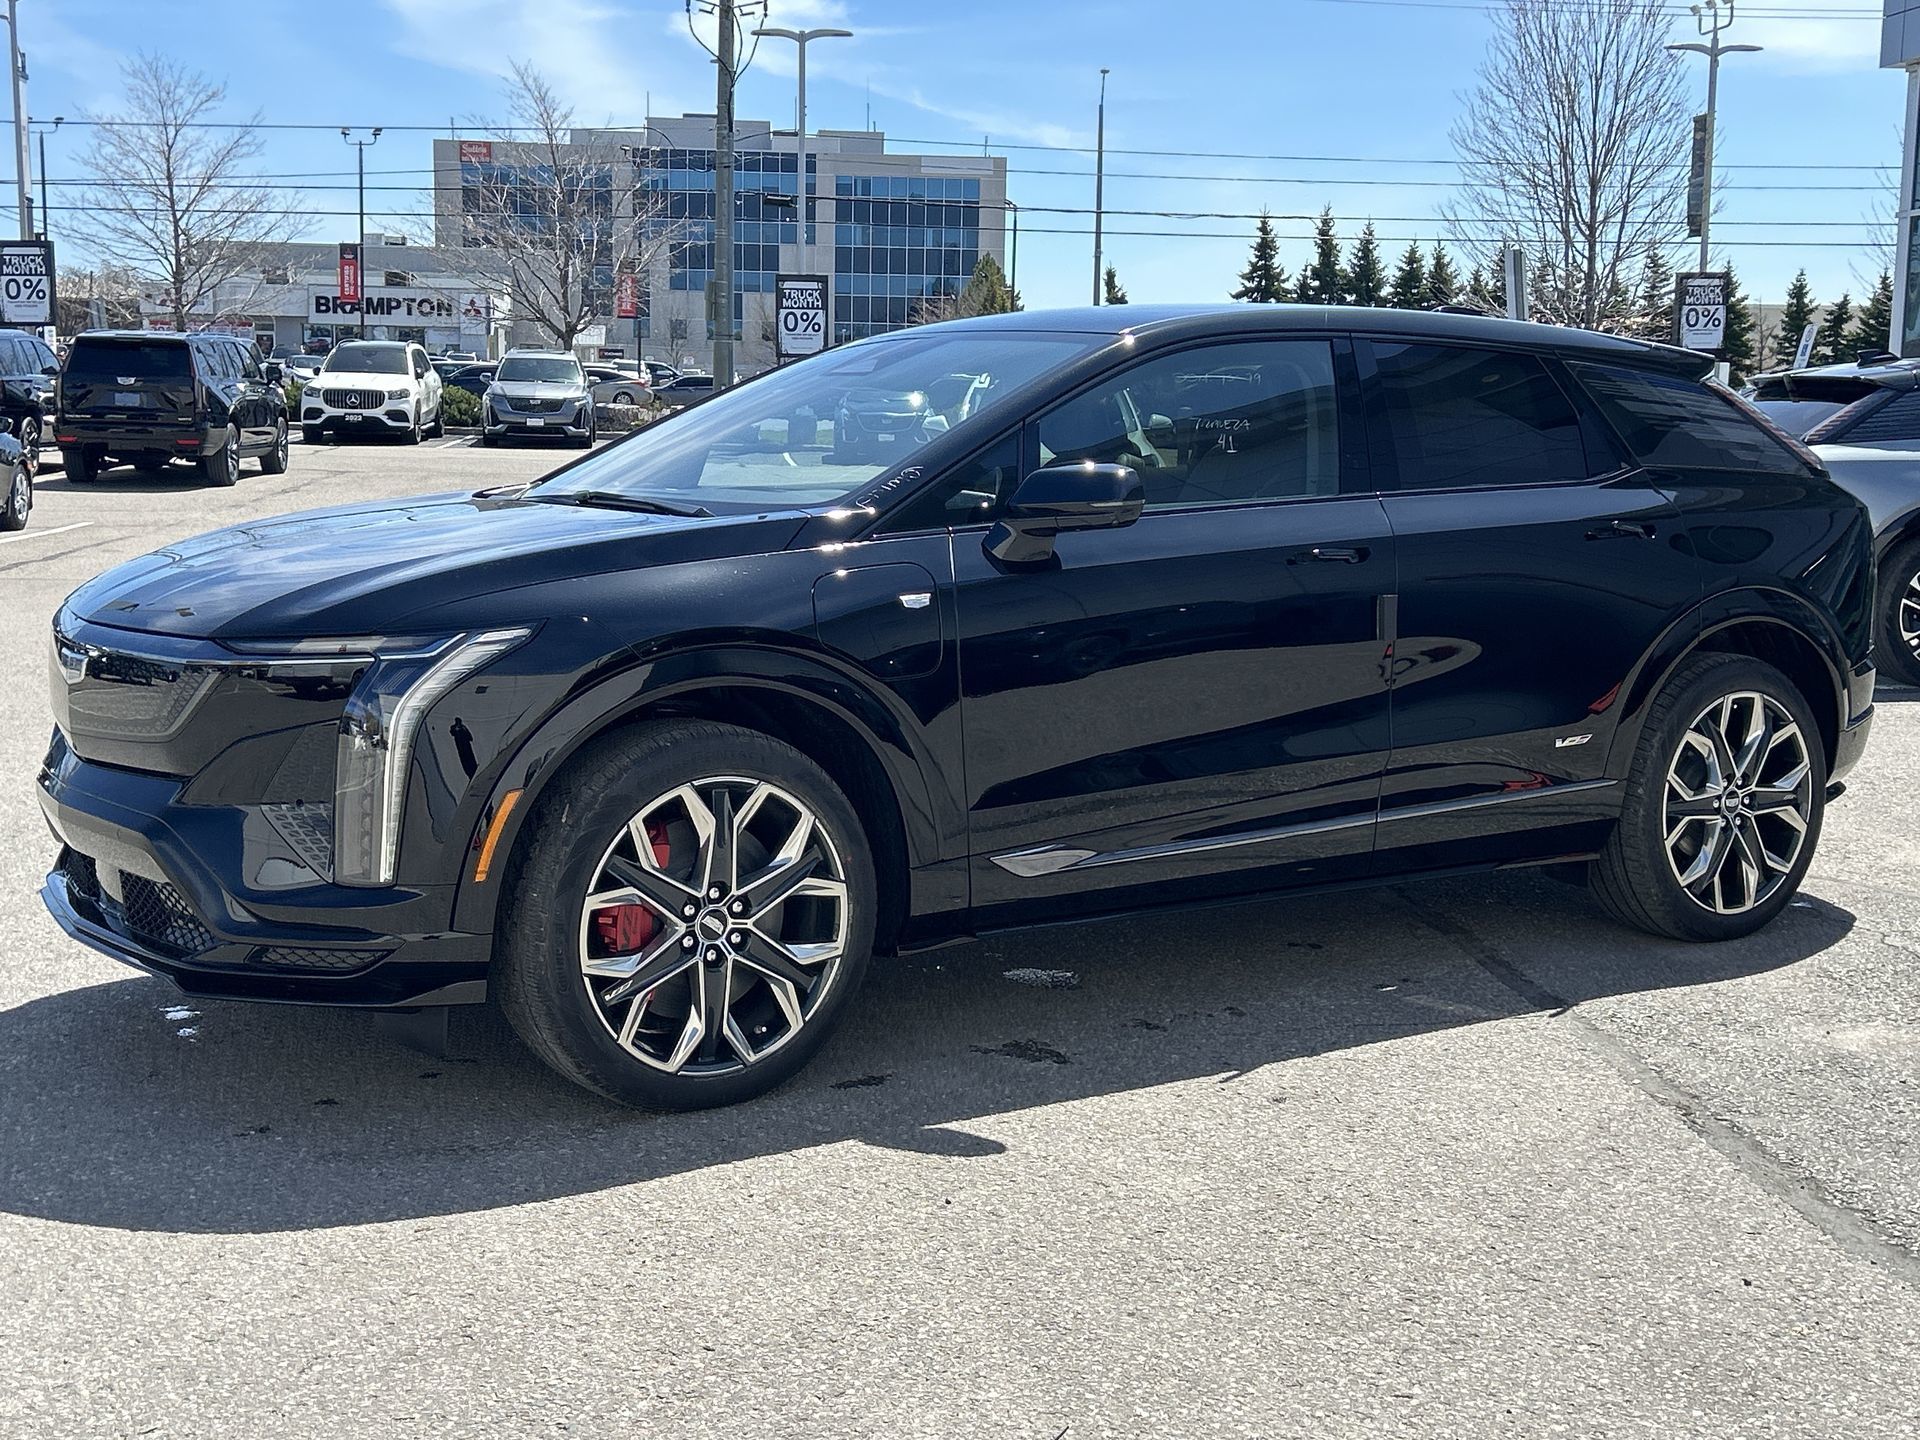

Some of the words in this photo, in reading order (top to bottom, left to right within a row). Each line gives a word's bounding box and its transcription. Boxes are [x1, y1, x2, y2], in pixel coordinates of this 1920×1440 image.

[3, 256, 44, 265] TRUCK
[3, 265, 46, 274] MONTH
[5, 278, 47, 300] 0%
[1687, 287, 1722, 296] TRUCK
[783, 289, 821, 299] TRUCK
[782, 299, 822, 308] MONTH
[1685, 296, 1723, 305] MONTH
[315, 295, 453, 317] BRAMPTON
[783, 311, 822, 333] 0%
[1685, 307, 1722, 328] 0%
